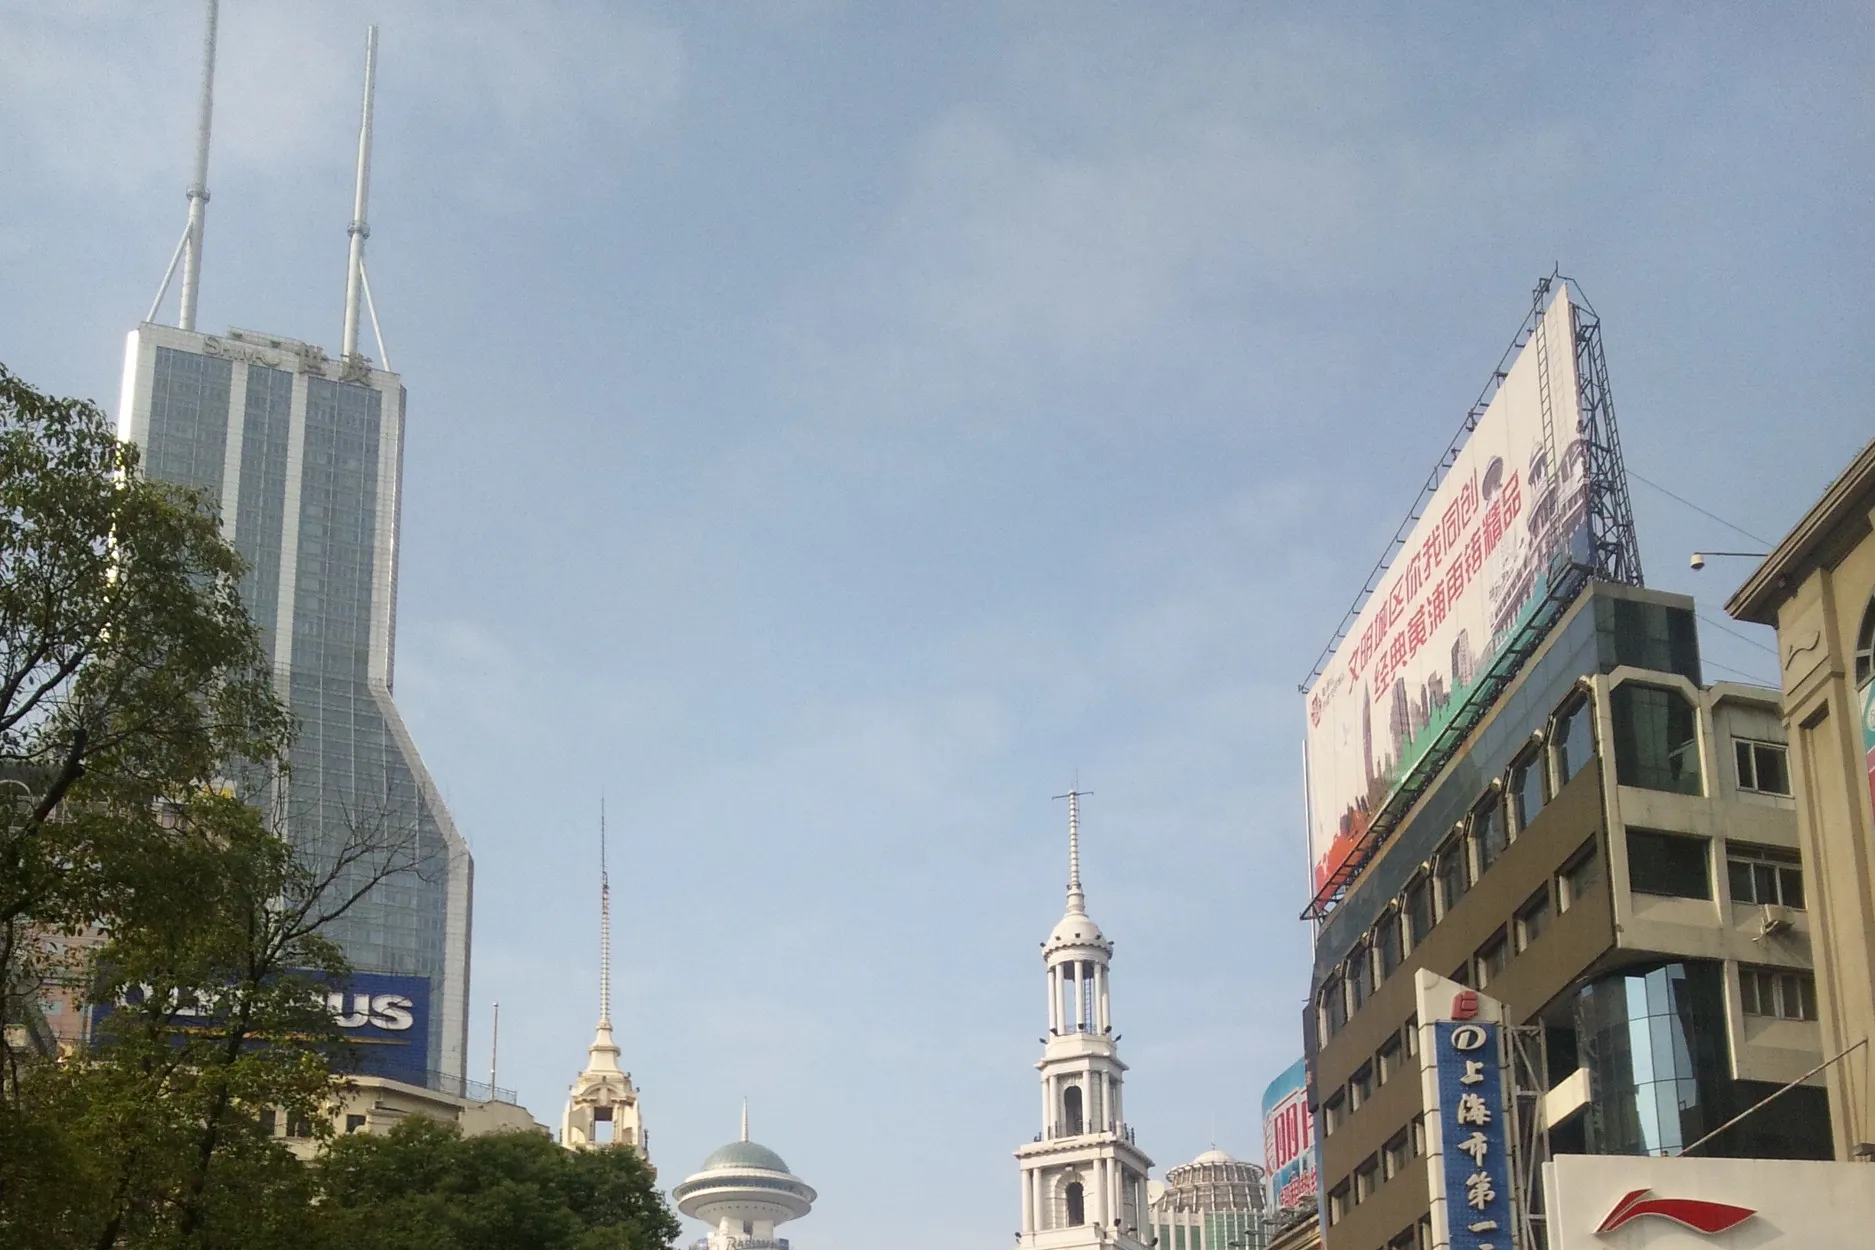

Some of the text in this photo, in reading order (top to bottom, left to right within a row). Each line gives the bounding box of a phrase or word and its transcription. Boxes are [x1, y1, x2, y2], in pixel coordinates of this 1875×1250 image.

[1349, 467, 1479, 695] 文明城区你我同创
[1374, 468, 1521, 704] 经典黄浦再铸精品
